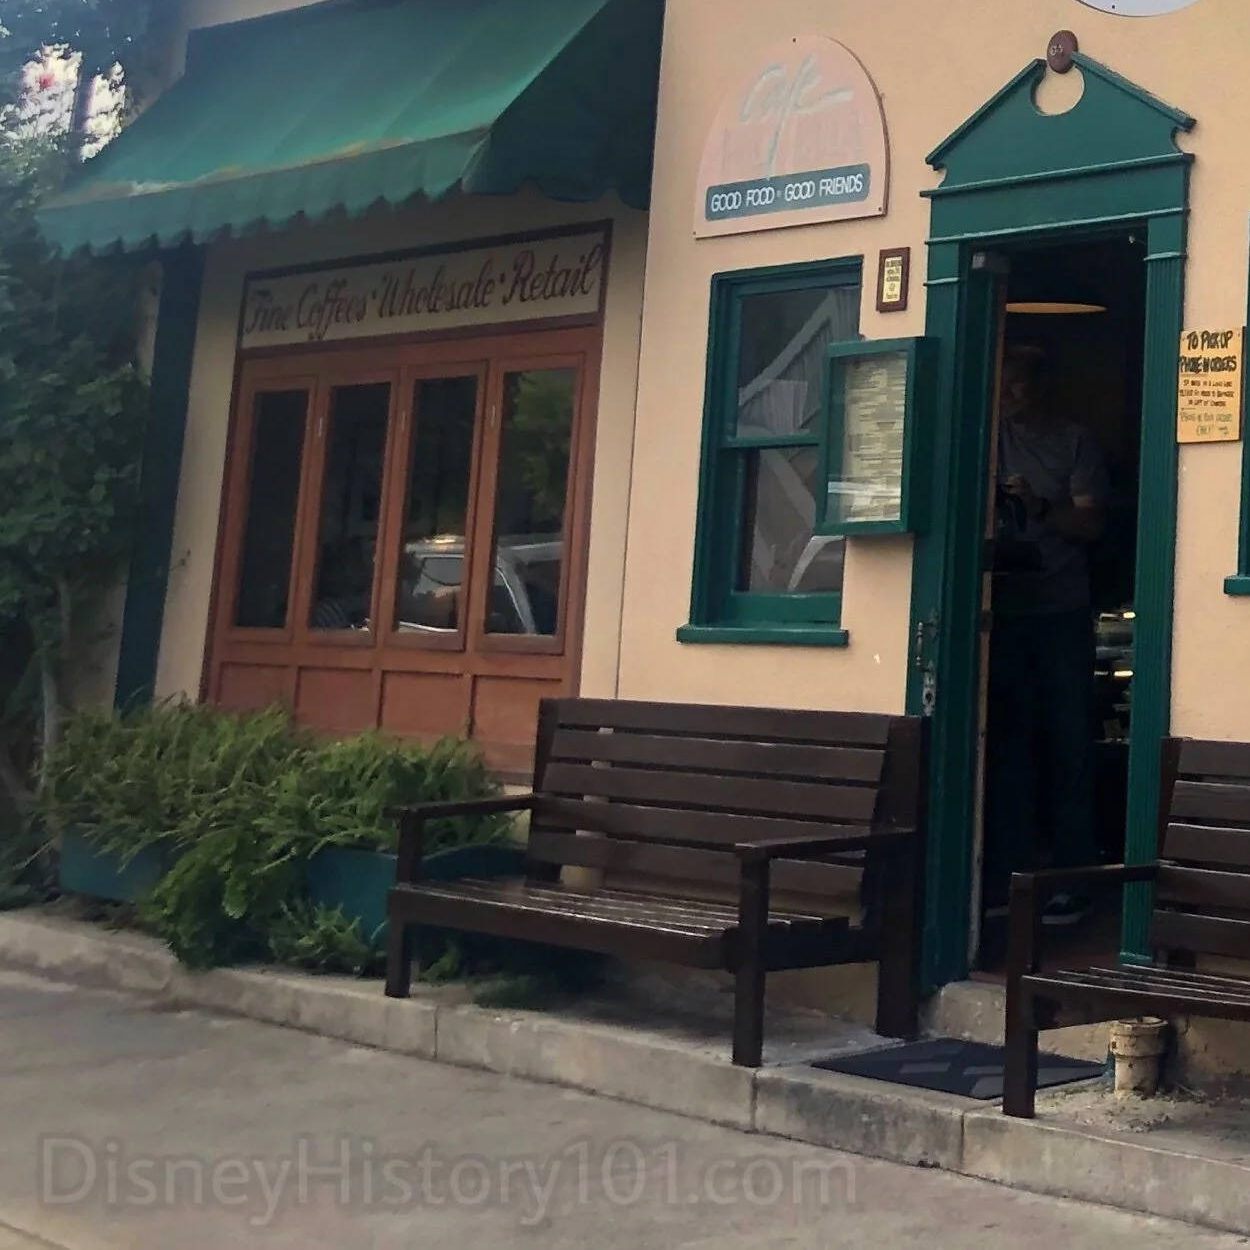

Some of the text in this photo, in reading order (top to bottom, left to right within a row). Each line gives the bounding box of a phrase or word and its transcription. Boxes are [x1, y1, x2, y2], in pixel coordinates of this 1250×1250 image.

[710, 173, 864, 213] GOOD FOOD GOOD FRIENDS
[246, 243, 602, 340] Fine Coffees Wholesale Retail
[1187, 331, 1199, 351] TO
